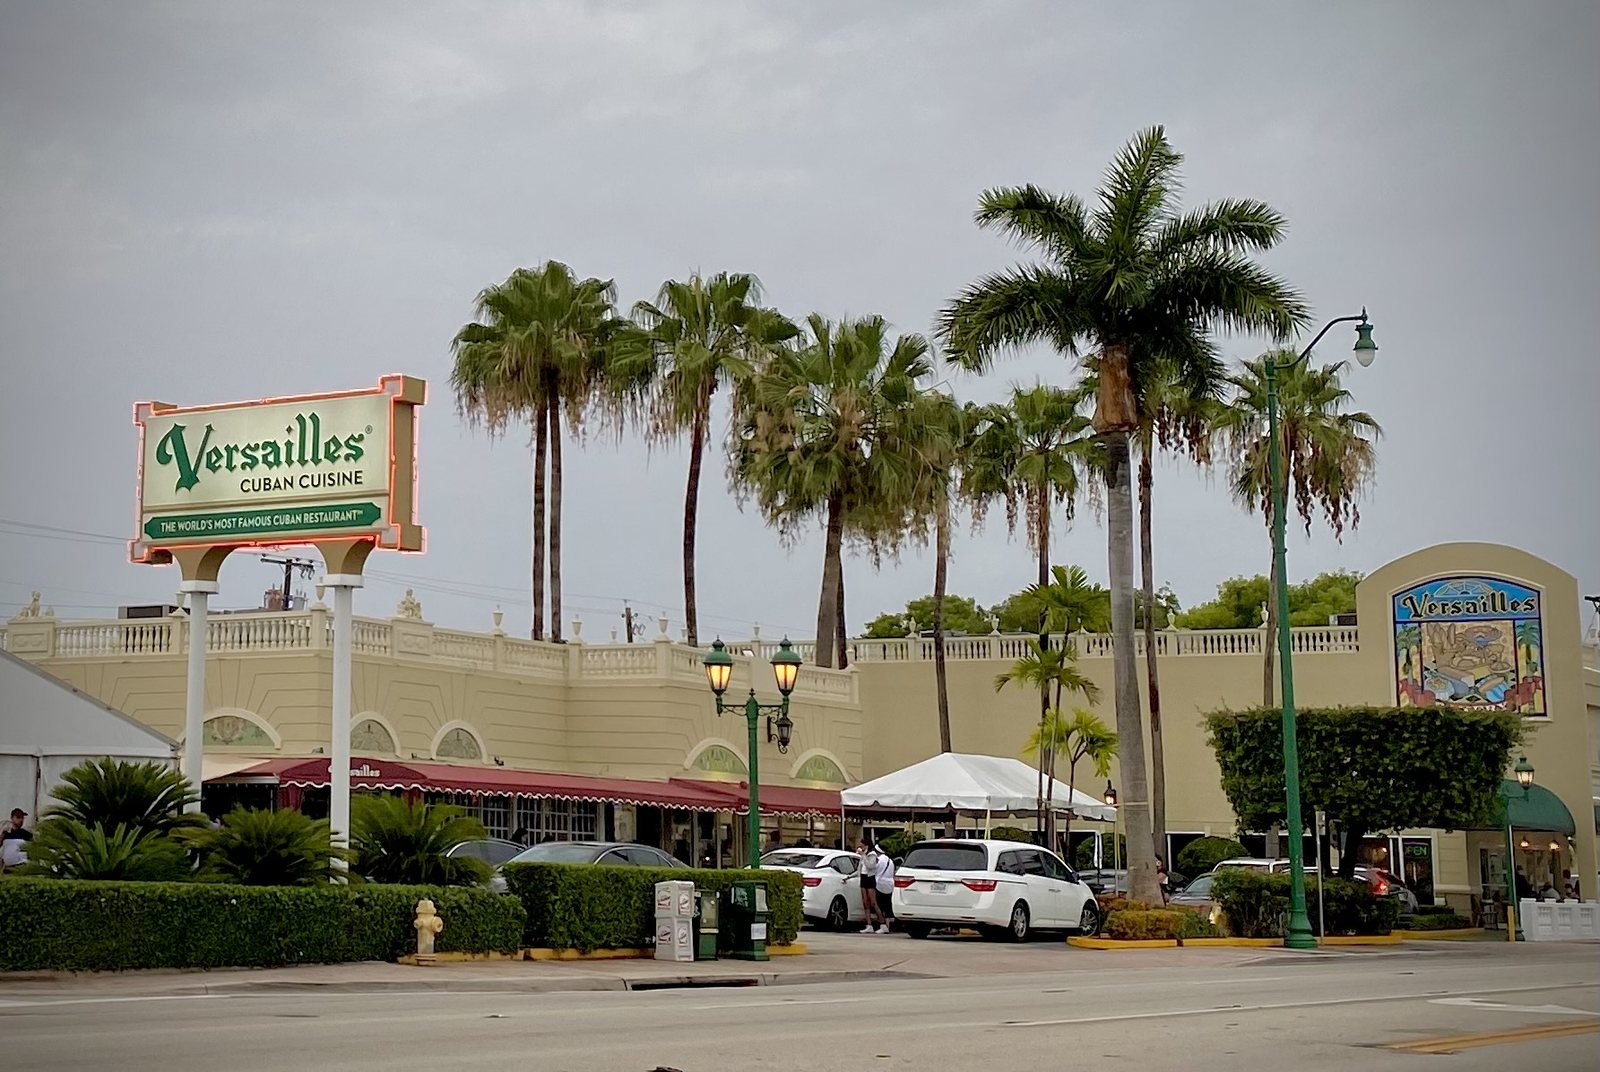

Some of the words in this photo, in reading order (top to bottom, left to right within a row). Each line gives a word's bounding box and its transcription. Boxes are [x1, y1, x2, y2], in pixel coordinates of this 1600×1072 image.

[240, 476, 295, 493] CUBAN
[298, 470, 363, 489] CUISINE
[160, 521, 177, 533] THE
[177, 518, 213, 532] WORLD'S
[213, 517, 237, 530] MOST
[237, 515, 272, 529] FAMOUS
[272, 513, 302, 527] CUBAN
[1402, 591, 1535, 618] Versailles
